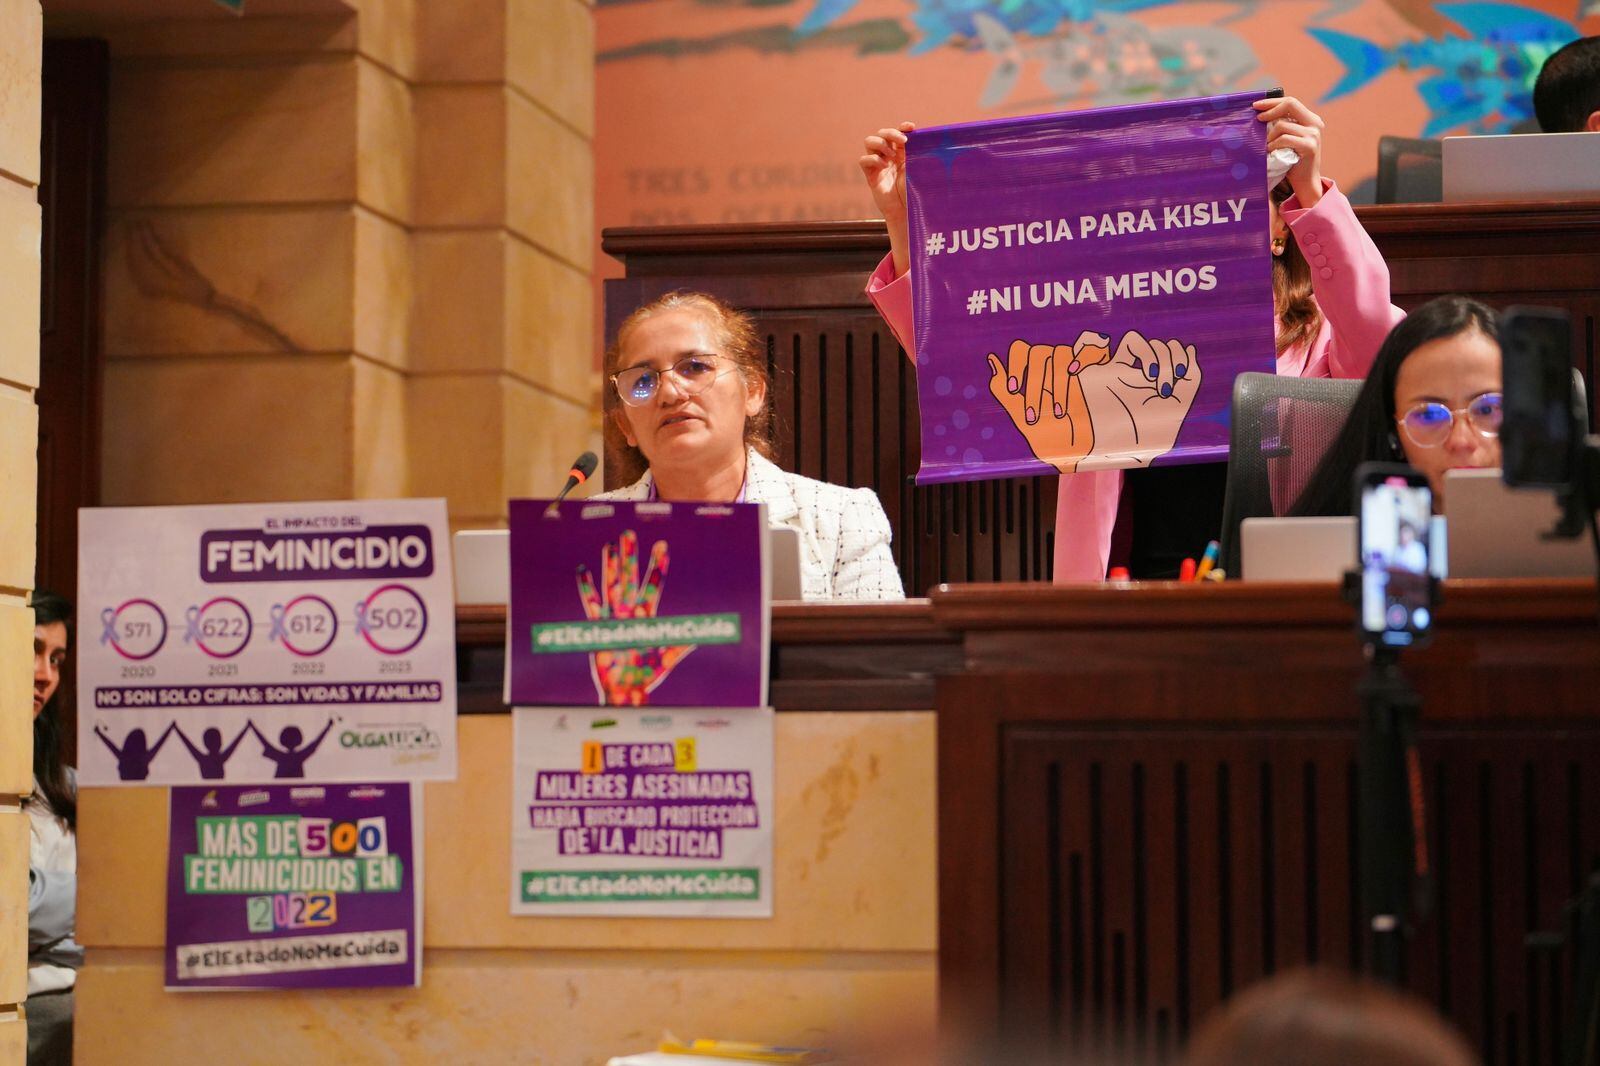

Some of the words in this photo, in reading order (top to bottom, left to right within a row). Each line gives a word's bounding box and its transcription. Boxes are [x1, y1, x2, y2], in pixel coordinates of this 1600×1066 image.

[925, 218, 1073, 256] #JUSTICIA
[1080, 208, 1156, 240] PARA
[1164, 197, 1247, 230] KISLY
[966, 285, 1022, 316] #NI
[1029, 278, 1098, 308] UNA
[1105, 265, 1218, 301] MENOS
[265, 518, 280, 529] EL
[284, 517, 338, 529] IMPACTO
[342, 515, 363, 527] DEL
[206, 534, 428, 573] FEMINICIDIO
[124, 622, 152, 639] 571
[202, 618, 243, 637] 622
[290, 614, 326, 634] 612
[370, 607, 418, 630] 502
[120, 666, 156, 679] 2020
[291, 662, 325, 675] 2022
[98, 691, 121, 705] NO
[124, 690, 153, 704] SON
[159, 689, 200, 704] SOLO
[265, 687, 298, 701] SON
[301, 685, 348, 700] VIDAS
[351, 685, 362, 698] Y
[365, 683, 440, 699] FAMILIAS
[605, 746, 627, 768] DE
[630, 744, 673, 767] CADA
[679, 741, 692, 764] 3
[540, 774, 627, 799] MUJERES
[631, 773, 750, 799] ASESINADAS
[204, 818, 257, 857] MÁS
[266, 821, 298, 856] DE
[306, 823, 381, 852] 500
[563, 829, 590, 853] DE
[599, 829, 625, 853] LA
[629, 829, 719, 857] JUSTICIA
[190, 858, 357, 890] FEMINICIDIOS
[366, 857, 397, 886] EN
[253, 895, 331, 927] 2022
[186, 940, 400, 968] #ElEstadoNoMeCuida
